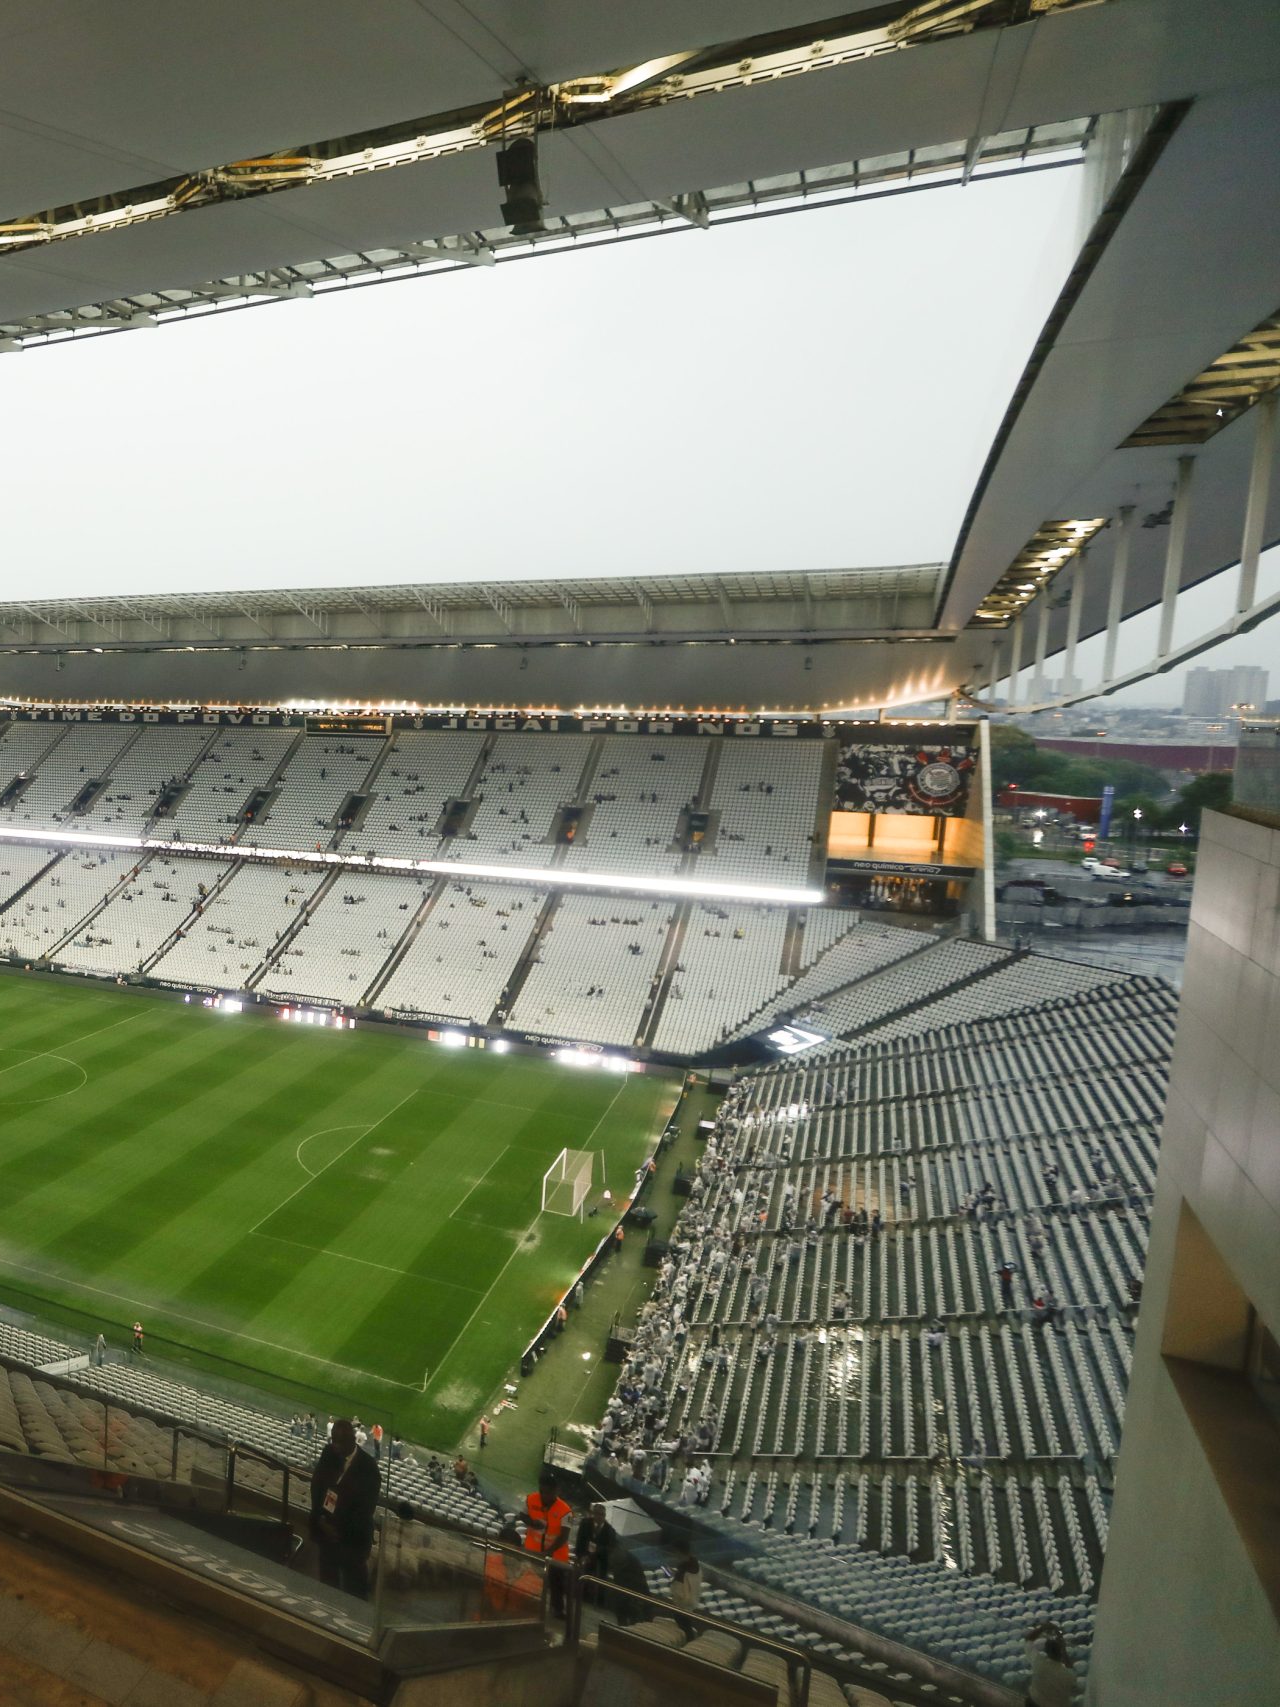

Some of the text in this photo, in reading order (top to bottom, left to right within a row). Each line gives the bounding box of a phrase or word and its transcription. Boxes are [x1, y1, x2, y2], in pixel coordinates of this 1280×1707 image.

[26, 711, 270, 725] TIME DO POVO
[442, 718, 559, 731] JOGAI
[582, 721, 674, 734] POR
